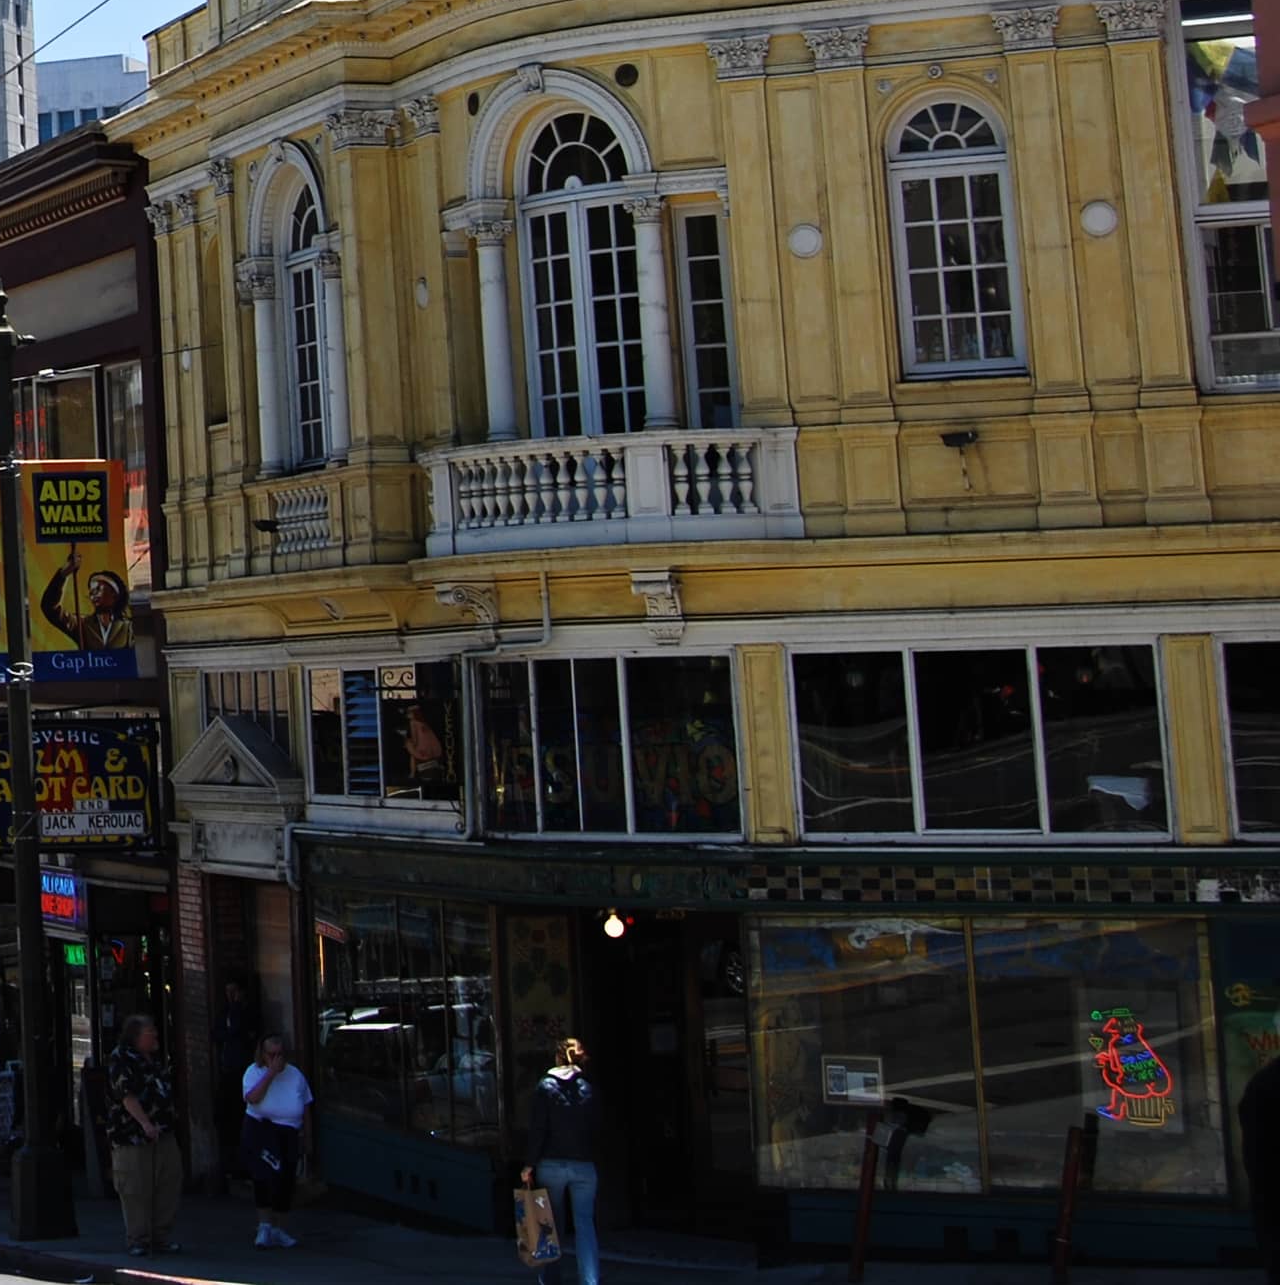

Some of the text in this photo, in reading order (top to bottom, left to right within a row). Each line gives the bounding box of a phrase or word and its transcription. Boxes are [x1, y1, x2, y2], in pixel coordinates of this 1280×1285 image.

[40, 480, 101, 502] AIDS
[40, 504, 102, 523] WALK
[41, 526, 103, 535] SAN FRANCISCO
[51, 652, 118, 674] Gap Inc.
[31, 729, 100, 745] SYCHIC
[104, 748, 128, 772] &
[72, 776, 145, 800] CARD
[45, 814, 142, 829] JACK KEROUAC
